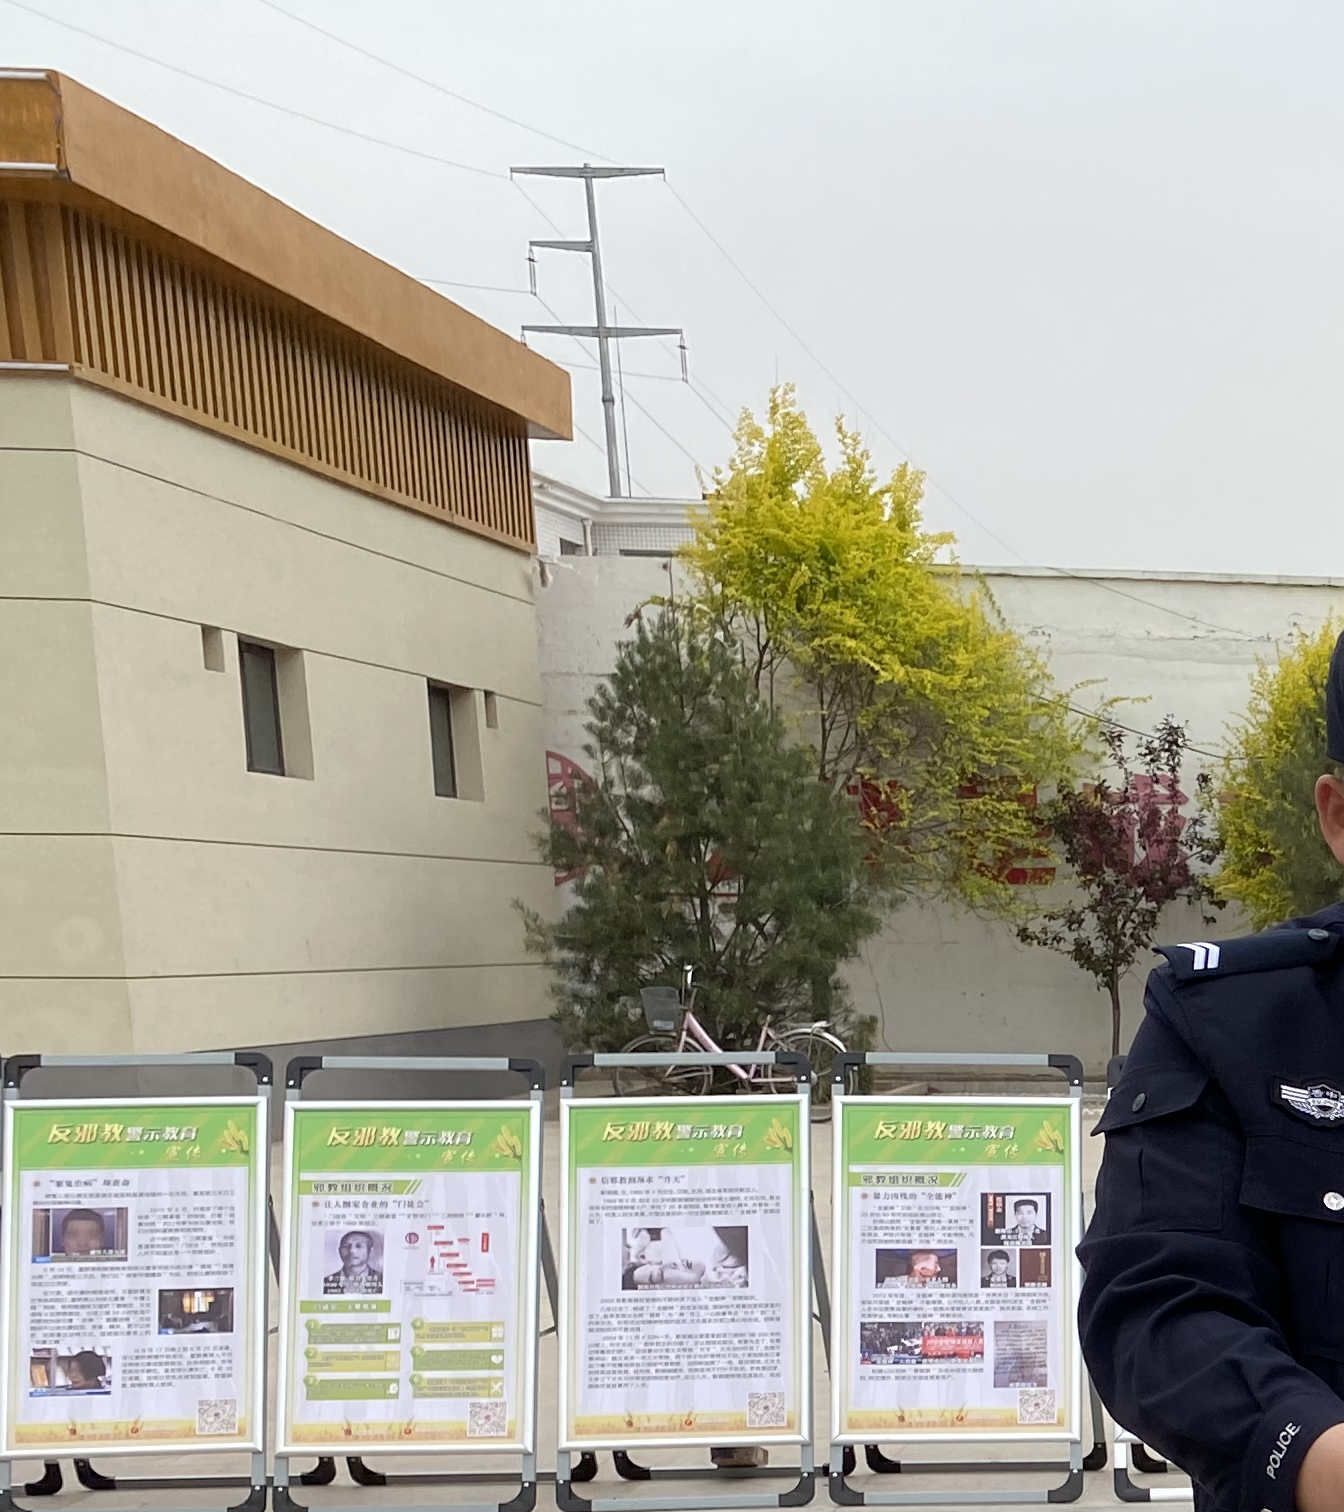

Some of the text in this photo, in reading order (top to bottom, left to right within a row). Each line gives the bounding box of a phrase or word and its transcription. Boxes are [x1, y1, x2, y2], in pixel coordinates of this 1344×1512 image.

[47, 1123, 199, 1144] 反邪教警示教育
[326, 1126, 474, 1147] 反邪教警示教育
[602, 1121, 745, 1142] 反邪教警示教育
[873, 1120, 1016, 1141] 反邪教警示教育
[166, 1145, 201, 1161] 宣传
[441, 1149, 476, 1165] 宣传
[713, 1143, 748, 1159] 宣传
[985, 1144, 1019, 1160] 宣传
[1266, 1422, 1301, 1480] POLICE
